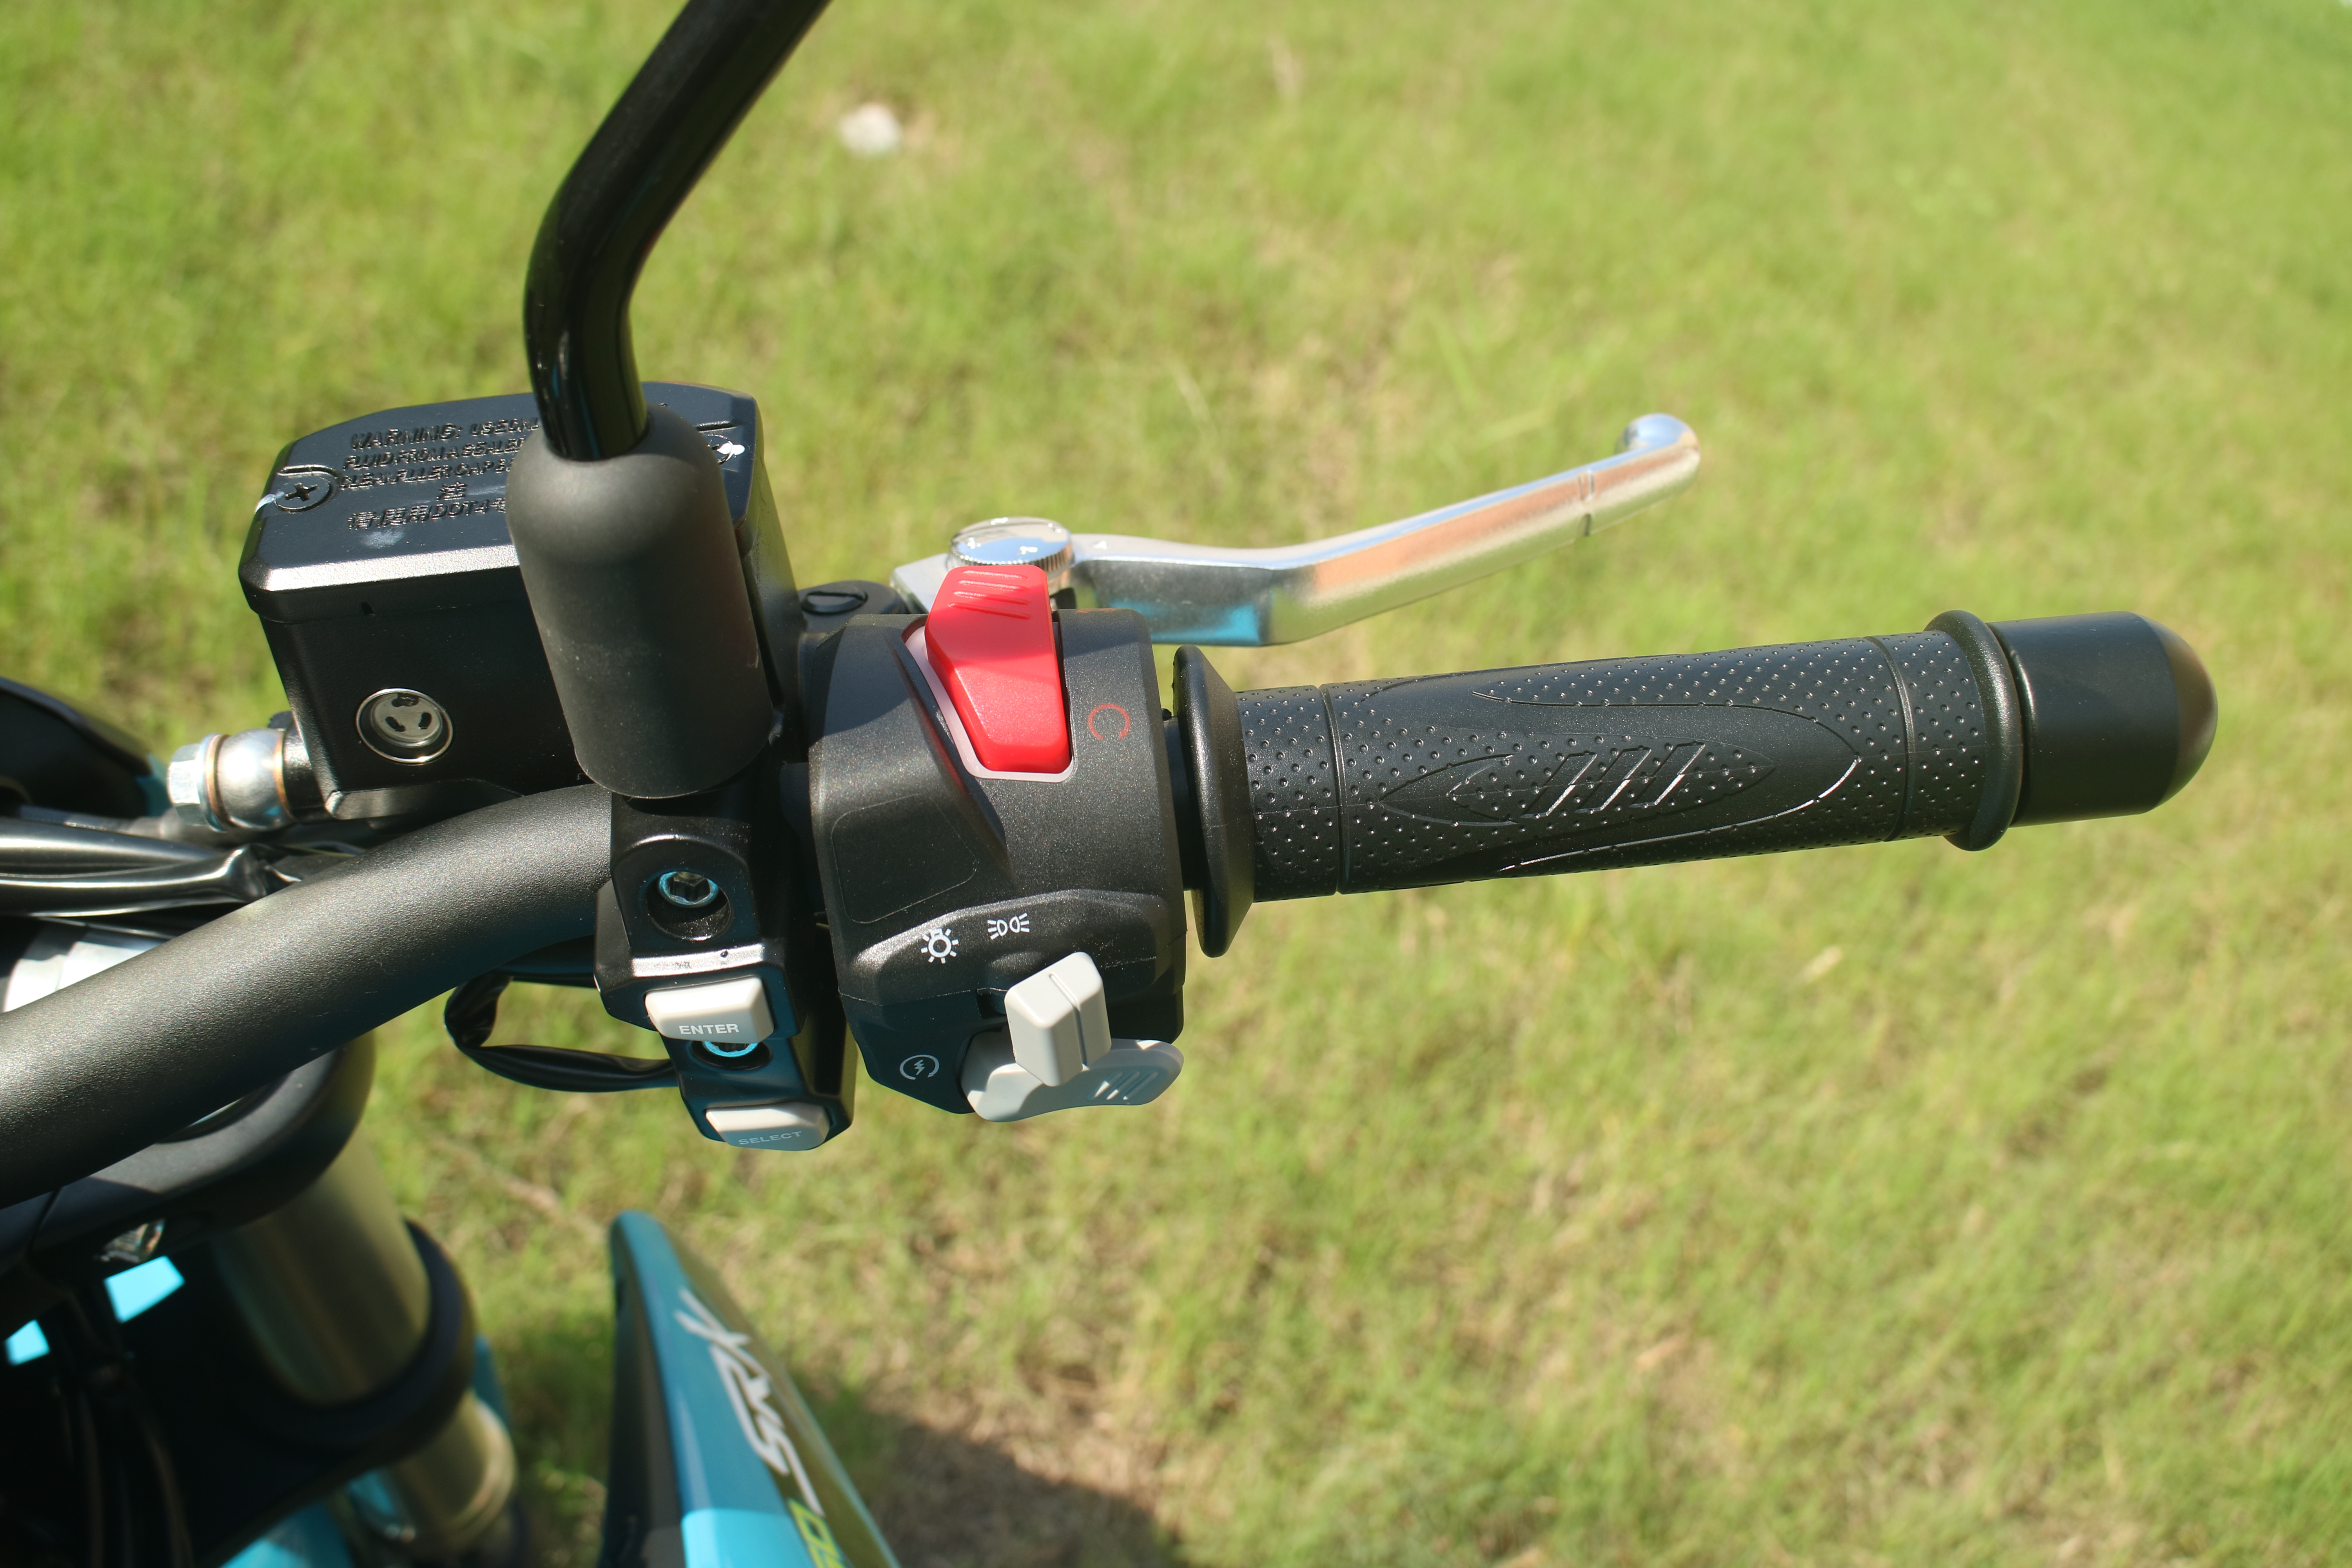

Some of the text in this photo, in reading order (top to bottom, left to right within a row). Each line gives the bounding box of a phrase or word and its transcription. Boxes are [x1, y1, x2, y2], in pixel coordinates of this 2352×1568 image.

[352, 417, 540, 450] WARNING: USE ONL
[342, 452, 395, 470] FLUID
[394, 448, 445, 465] FROM
[340, 473, 396, 490] CLEAN
[454, 460, 494, 477] CAP
[679, 1024, 740, 1035] ENTER
[738, 1131, 802, 1145] SELECT
[673, 1287, 826, 1518] SRX
